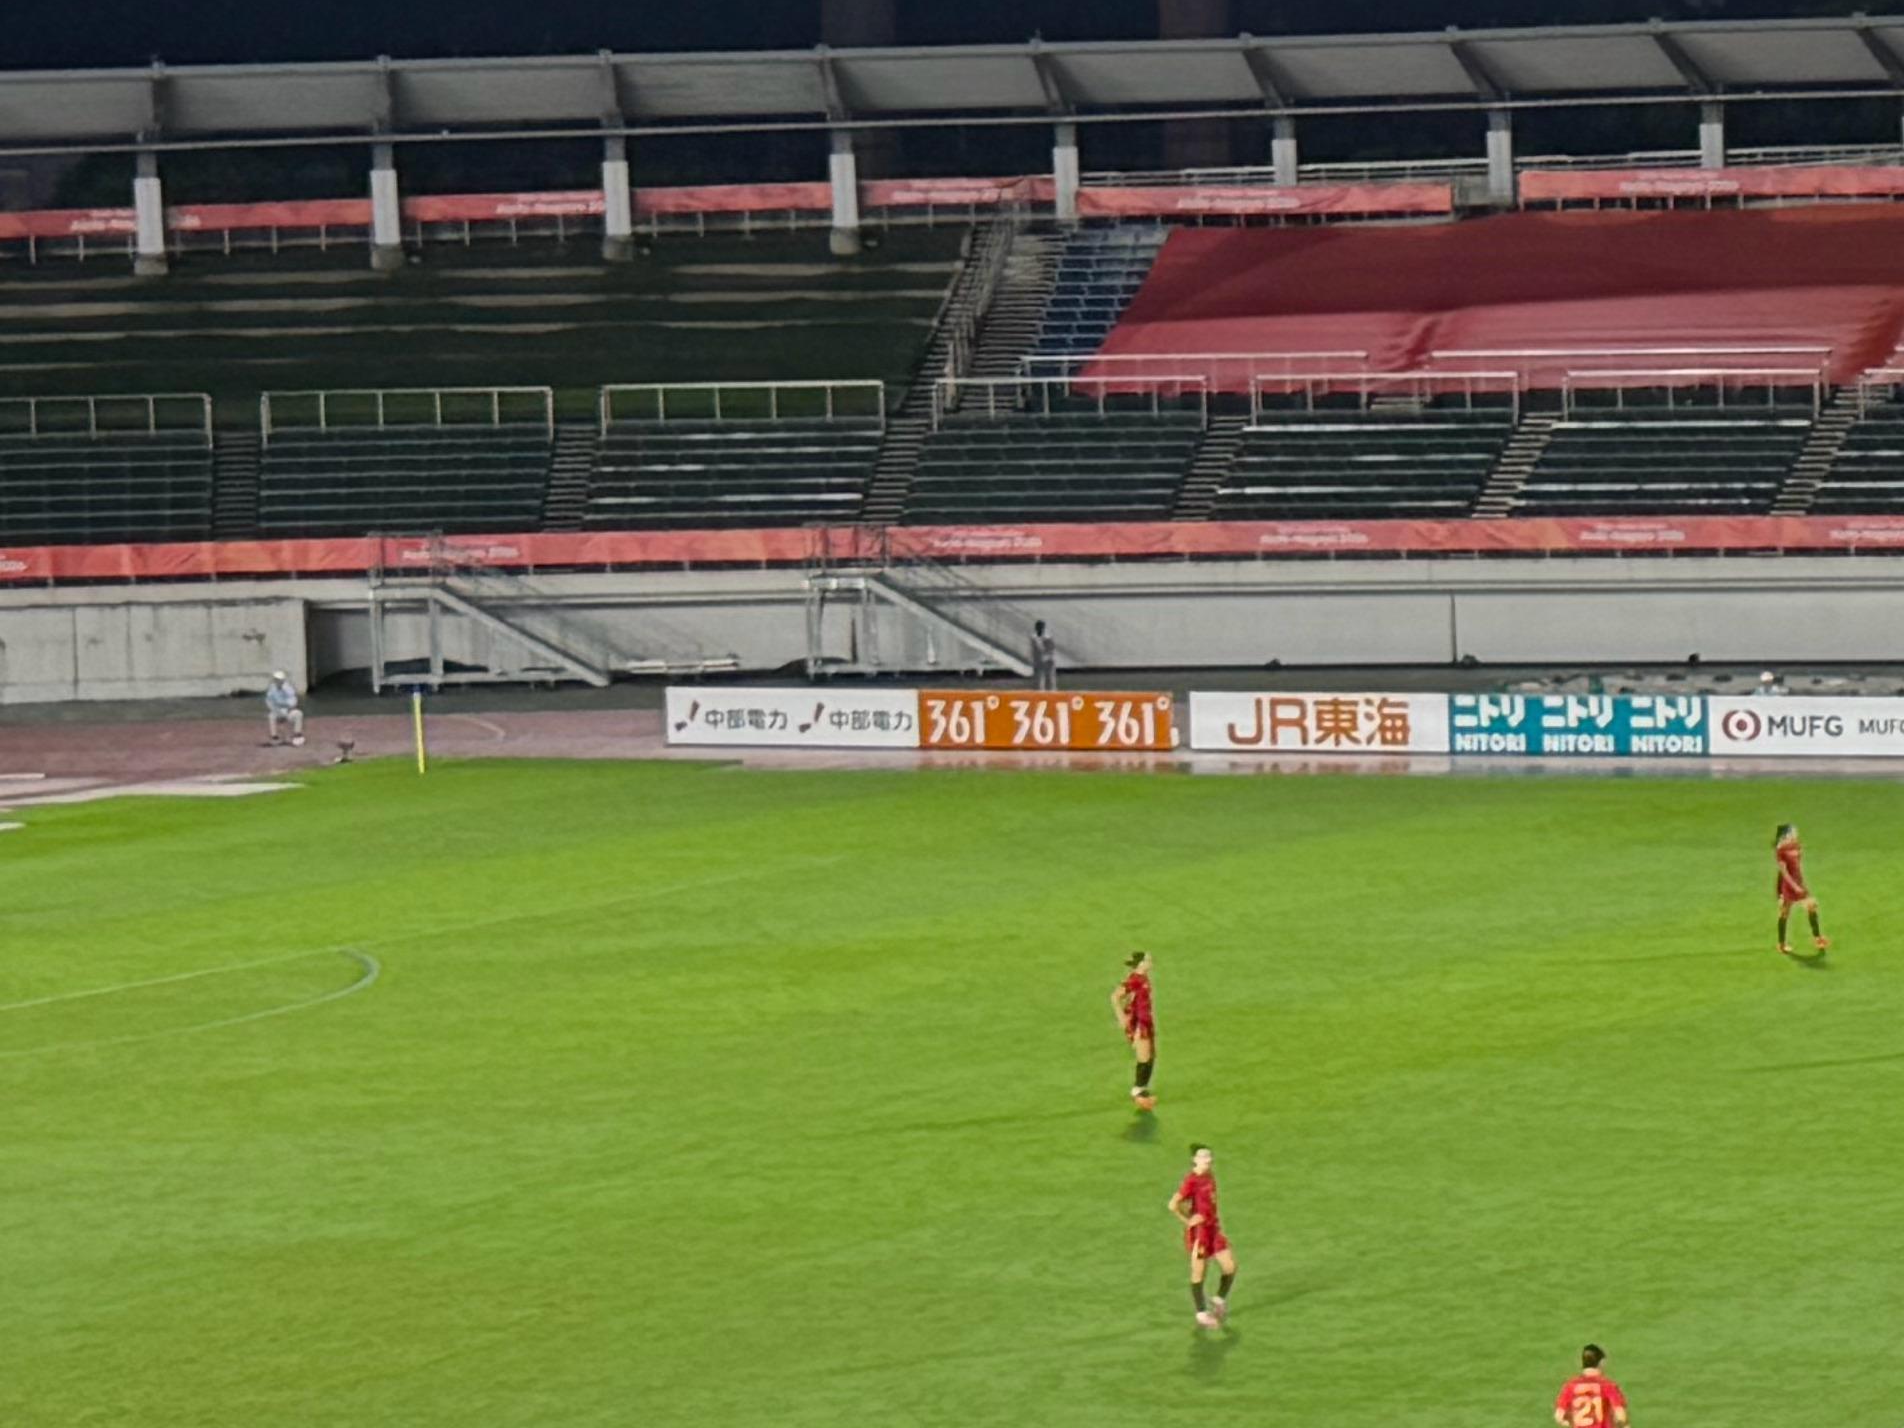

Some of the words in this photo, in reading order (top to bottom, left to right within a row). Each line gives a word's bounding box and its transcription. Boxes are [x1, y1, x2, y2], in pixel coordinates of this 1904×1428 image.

[704, 707, 788, 731] 中部電力
[829, 708, 912, 732] 中部電力
[1227, 697, 1410, 746] JR東海
[1455, 695, 1525, 727] ニトリ
[1543, 695, 1613, 728] ニトリ
[1631, 697, 1702, 729] ニトリ
[1768, 715, 1844, 737] MUFG
[1455, 733, 1526, 753] NITORI
[1543, 733, 1615, 753] NITORI
[1631, 734, 1703, 753] NITORI
[1572, 1395, 1604, 1427] 21
